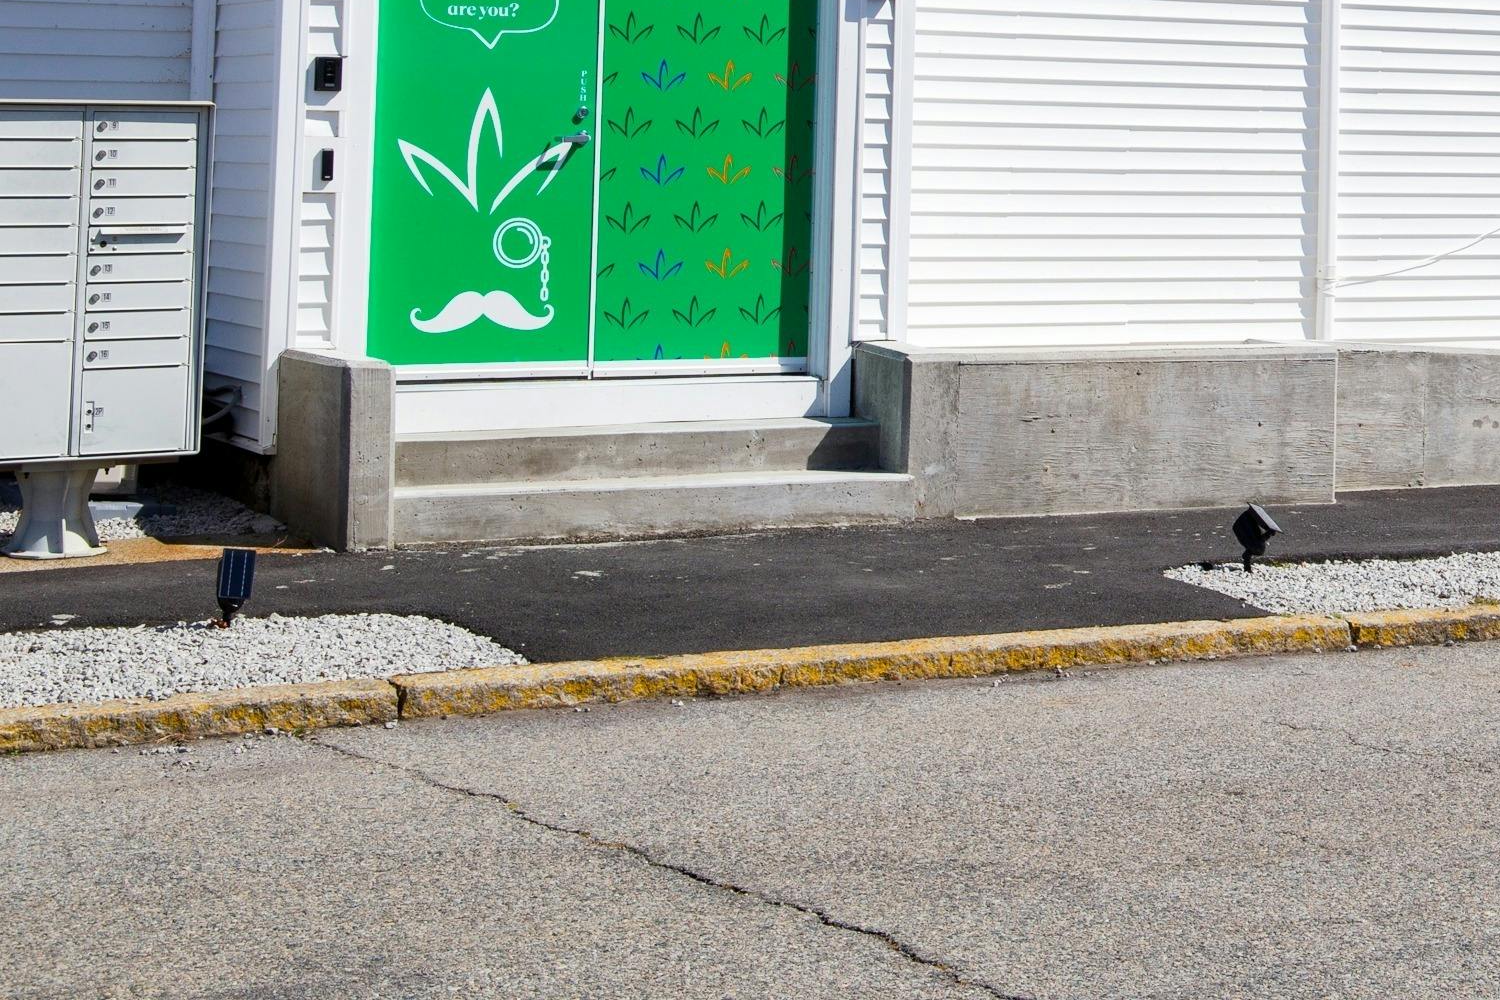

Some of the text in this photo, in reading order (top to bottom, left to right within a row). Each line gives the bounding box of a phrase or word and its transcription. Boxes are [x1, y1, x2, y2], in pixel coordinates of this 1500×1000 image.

[447, 2, 520, 20] are you?
[579, 69, 588, 102] PUSH
